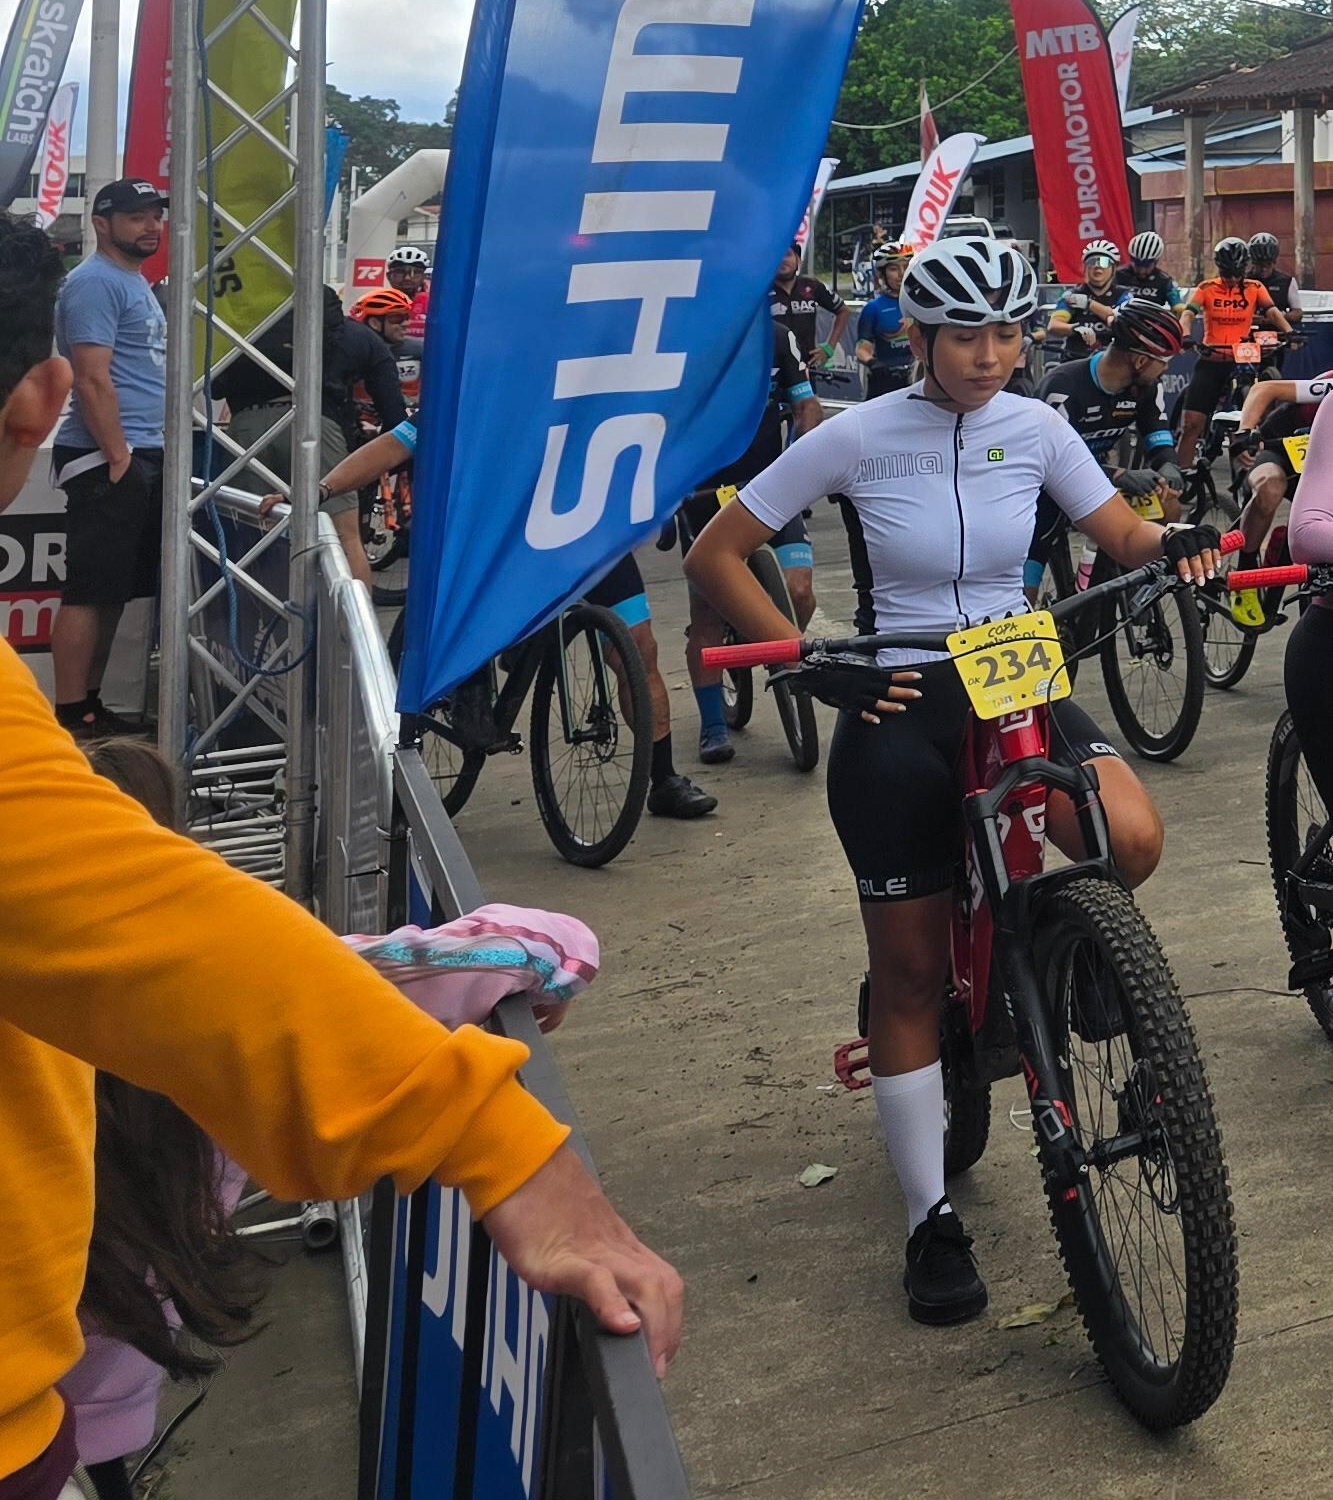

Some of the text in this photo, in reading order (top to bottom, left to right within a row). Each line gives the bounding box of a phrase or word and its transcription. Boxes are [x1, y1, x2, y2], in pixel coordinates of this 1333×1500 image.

[9, 0, 70, 136] skratch
[1025, 22, 1101, 60] MTB
[6, 131, 35, 146] LABS
[38, 118, 67, 218] MOUK
[1056, 60, 1105, 241] PUROMOTOR
[913, 155, 961, 251] MOUK
[975, 641, 1052, 689] 234
[987, 622, 1019, 639] COPA
